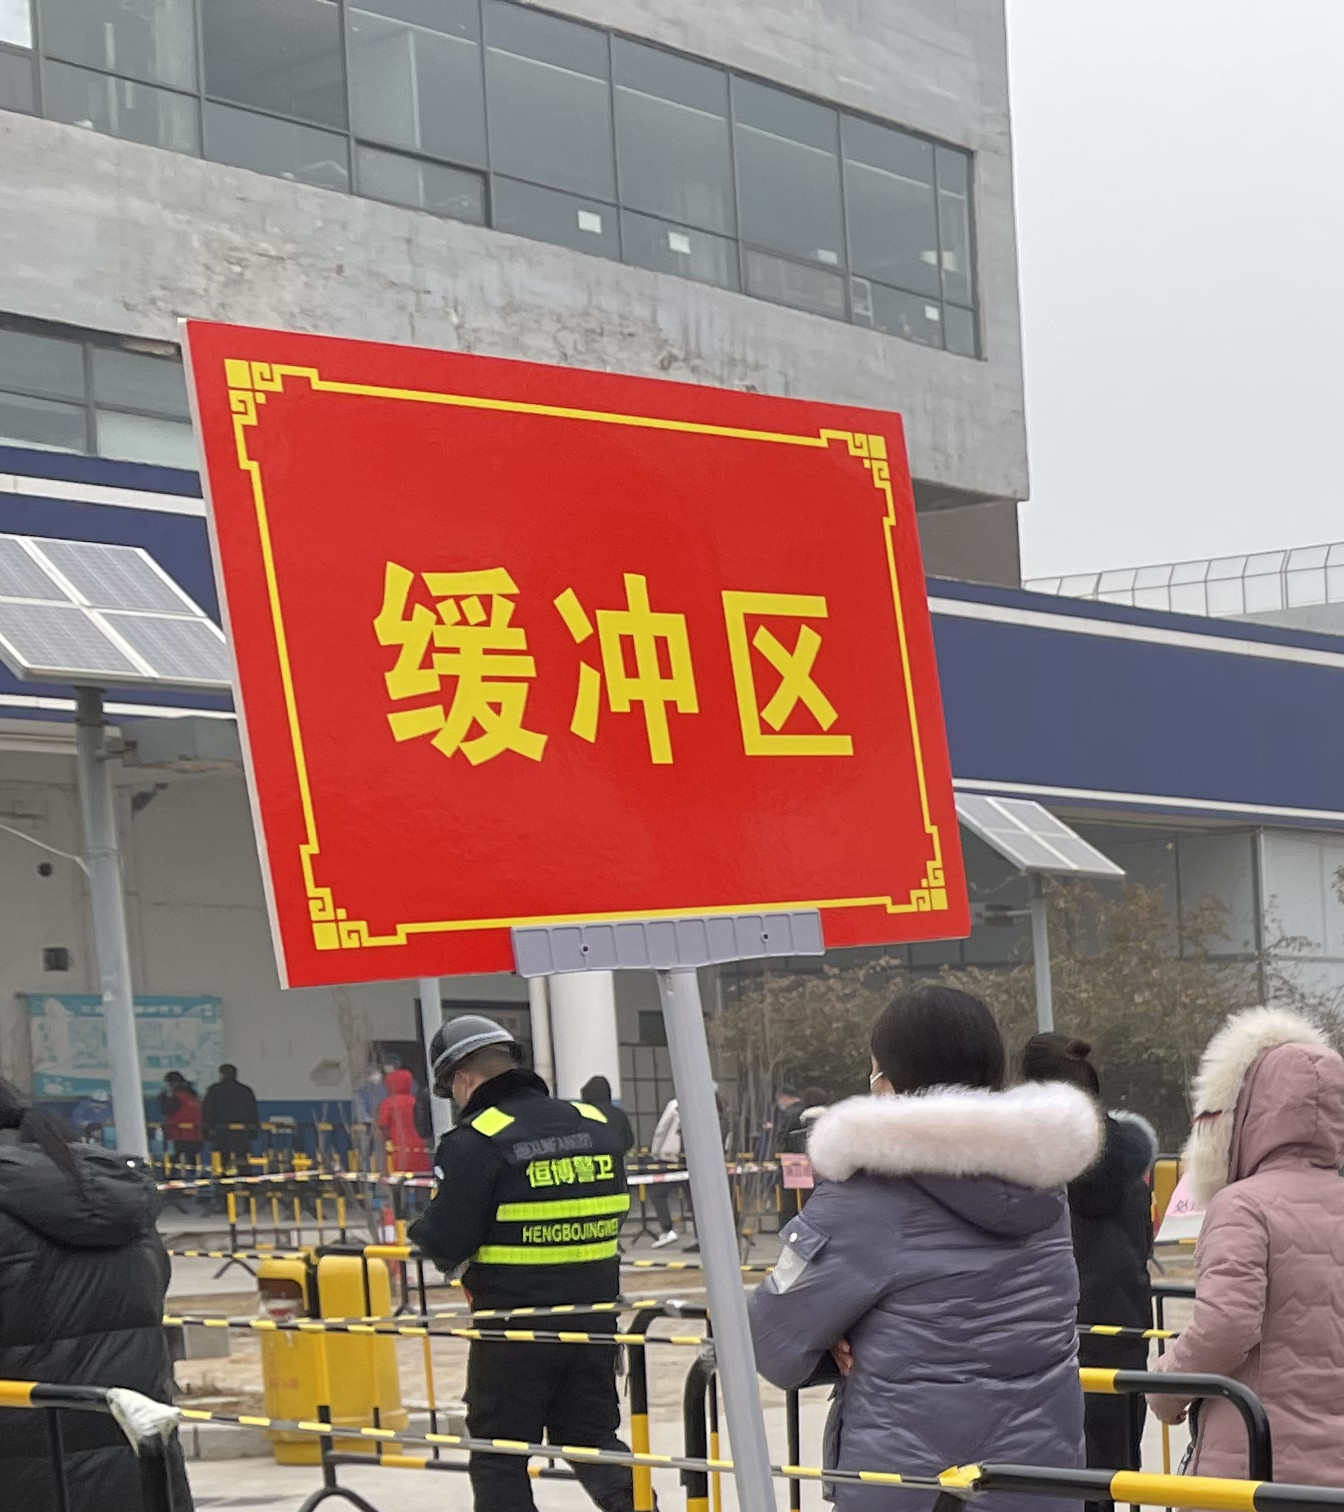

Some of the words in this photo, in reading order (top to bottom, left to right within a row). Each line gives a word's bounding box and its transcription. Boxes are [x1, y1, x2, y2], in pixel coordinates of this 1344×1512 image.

[373, 561, 854, 766] 缓冲区
[525, 1154, 614, 1188] 恒博警卫
